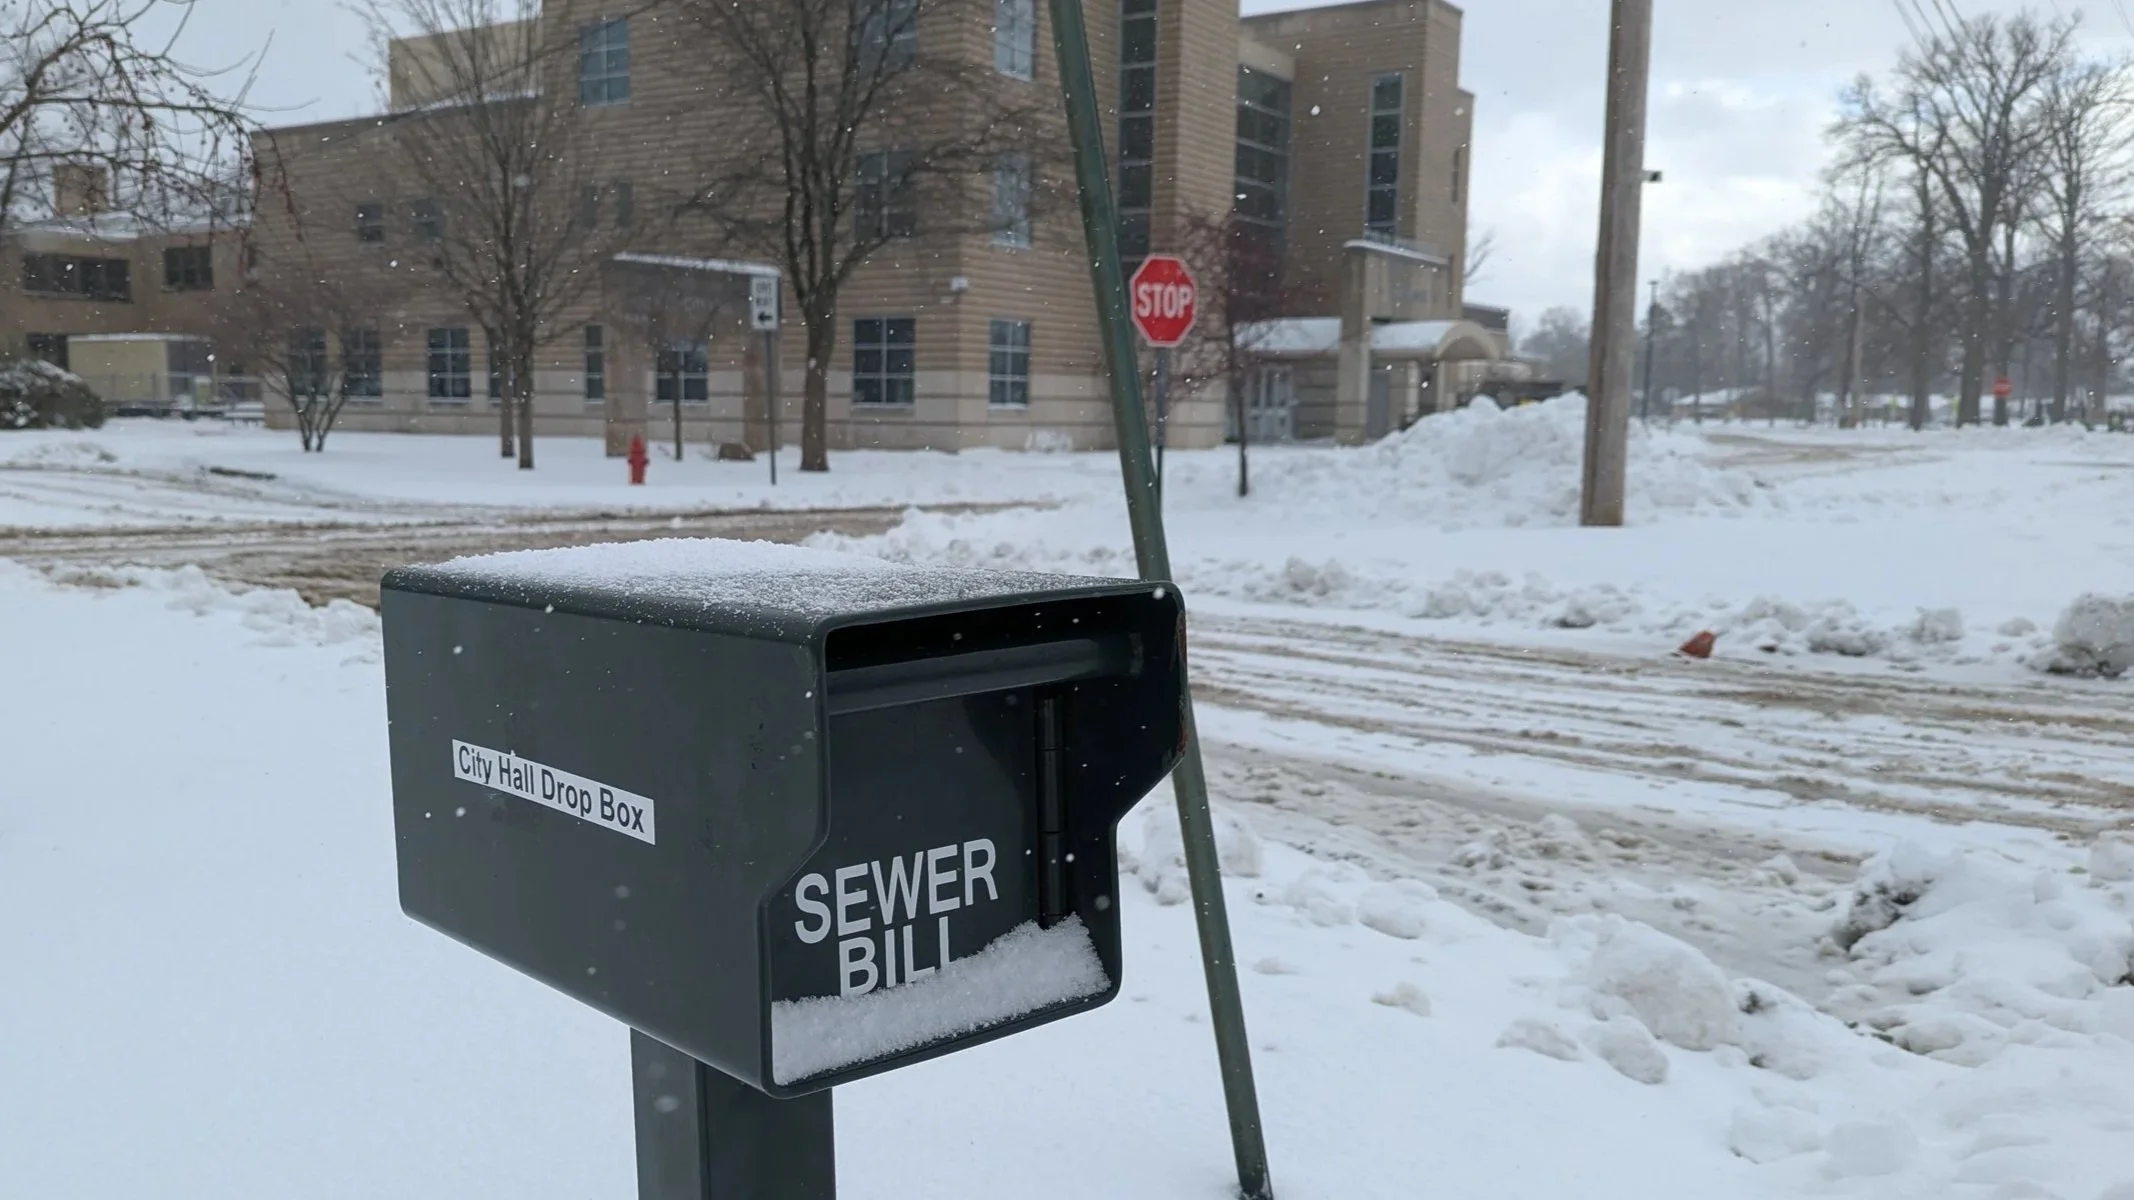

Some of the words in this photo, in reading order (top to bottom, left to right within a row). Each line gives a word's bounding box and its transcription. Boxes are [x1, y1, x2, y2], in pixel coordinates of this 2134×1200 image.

[1137, 282, 1193, 318] STOP
[459, 745, 492, 784] City
[499, 755, 535, 795] Hall
[541, 768, 592, 817] Drop
[600, 787, 645, 834] Box
[795, 838, 999, 944] SEWER
